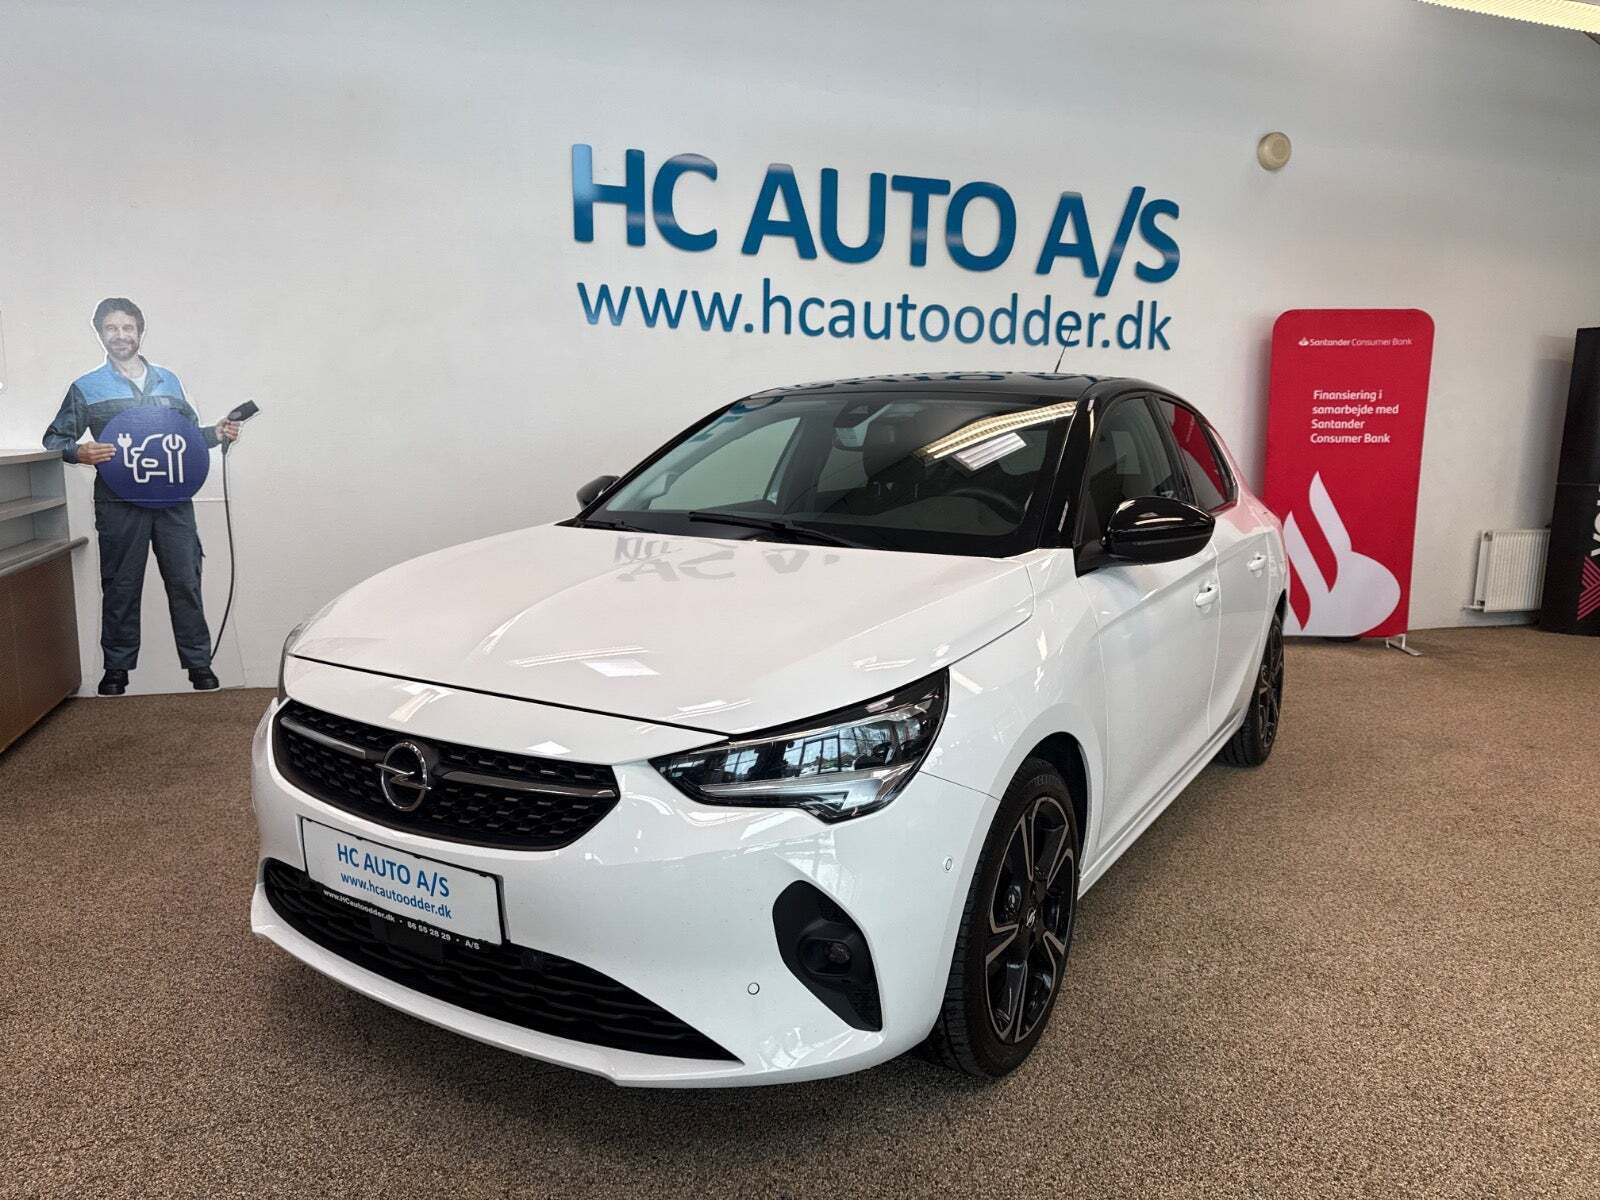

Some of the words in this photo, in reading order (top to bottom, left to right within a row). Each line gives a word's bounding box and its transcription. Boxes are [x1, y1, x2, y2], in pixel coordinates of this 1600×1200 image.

[572, 143, 718, 251] HC
[741, 162, 1017, 272] AUTO
[1035, 185, 1181, 297] A/S
[576, 277, 1172, 351] www.hcautoodder.dk
[1310, 338, 1350, 346] Santander
[1352, 338, 1391, 346] Consumer
[1392, 337, 1412, 346] Bank
[1313, 389, 1377, 402] Finansiering
[1379, 389, 1383, 400] i
[1312, 404, 1374, 417] samarbejde
[1375, 404, 1399, 414] med
[1311, 419, 1366, 429] Santander
[1310, 433, 1363, 444] Consumer
[1364, 433, 1391, 444] Bank
[336, 843, 360, 868] HC
[363, 852, 411, 886] AUTO
[416, 870, 450, 898] A/S
[340, 872, 452, 920] www.hcautoodder.dk
